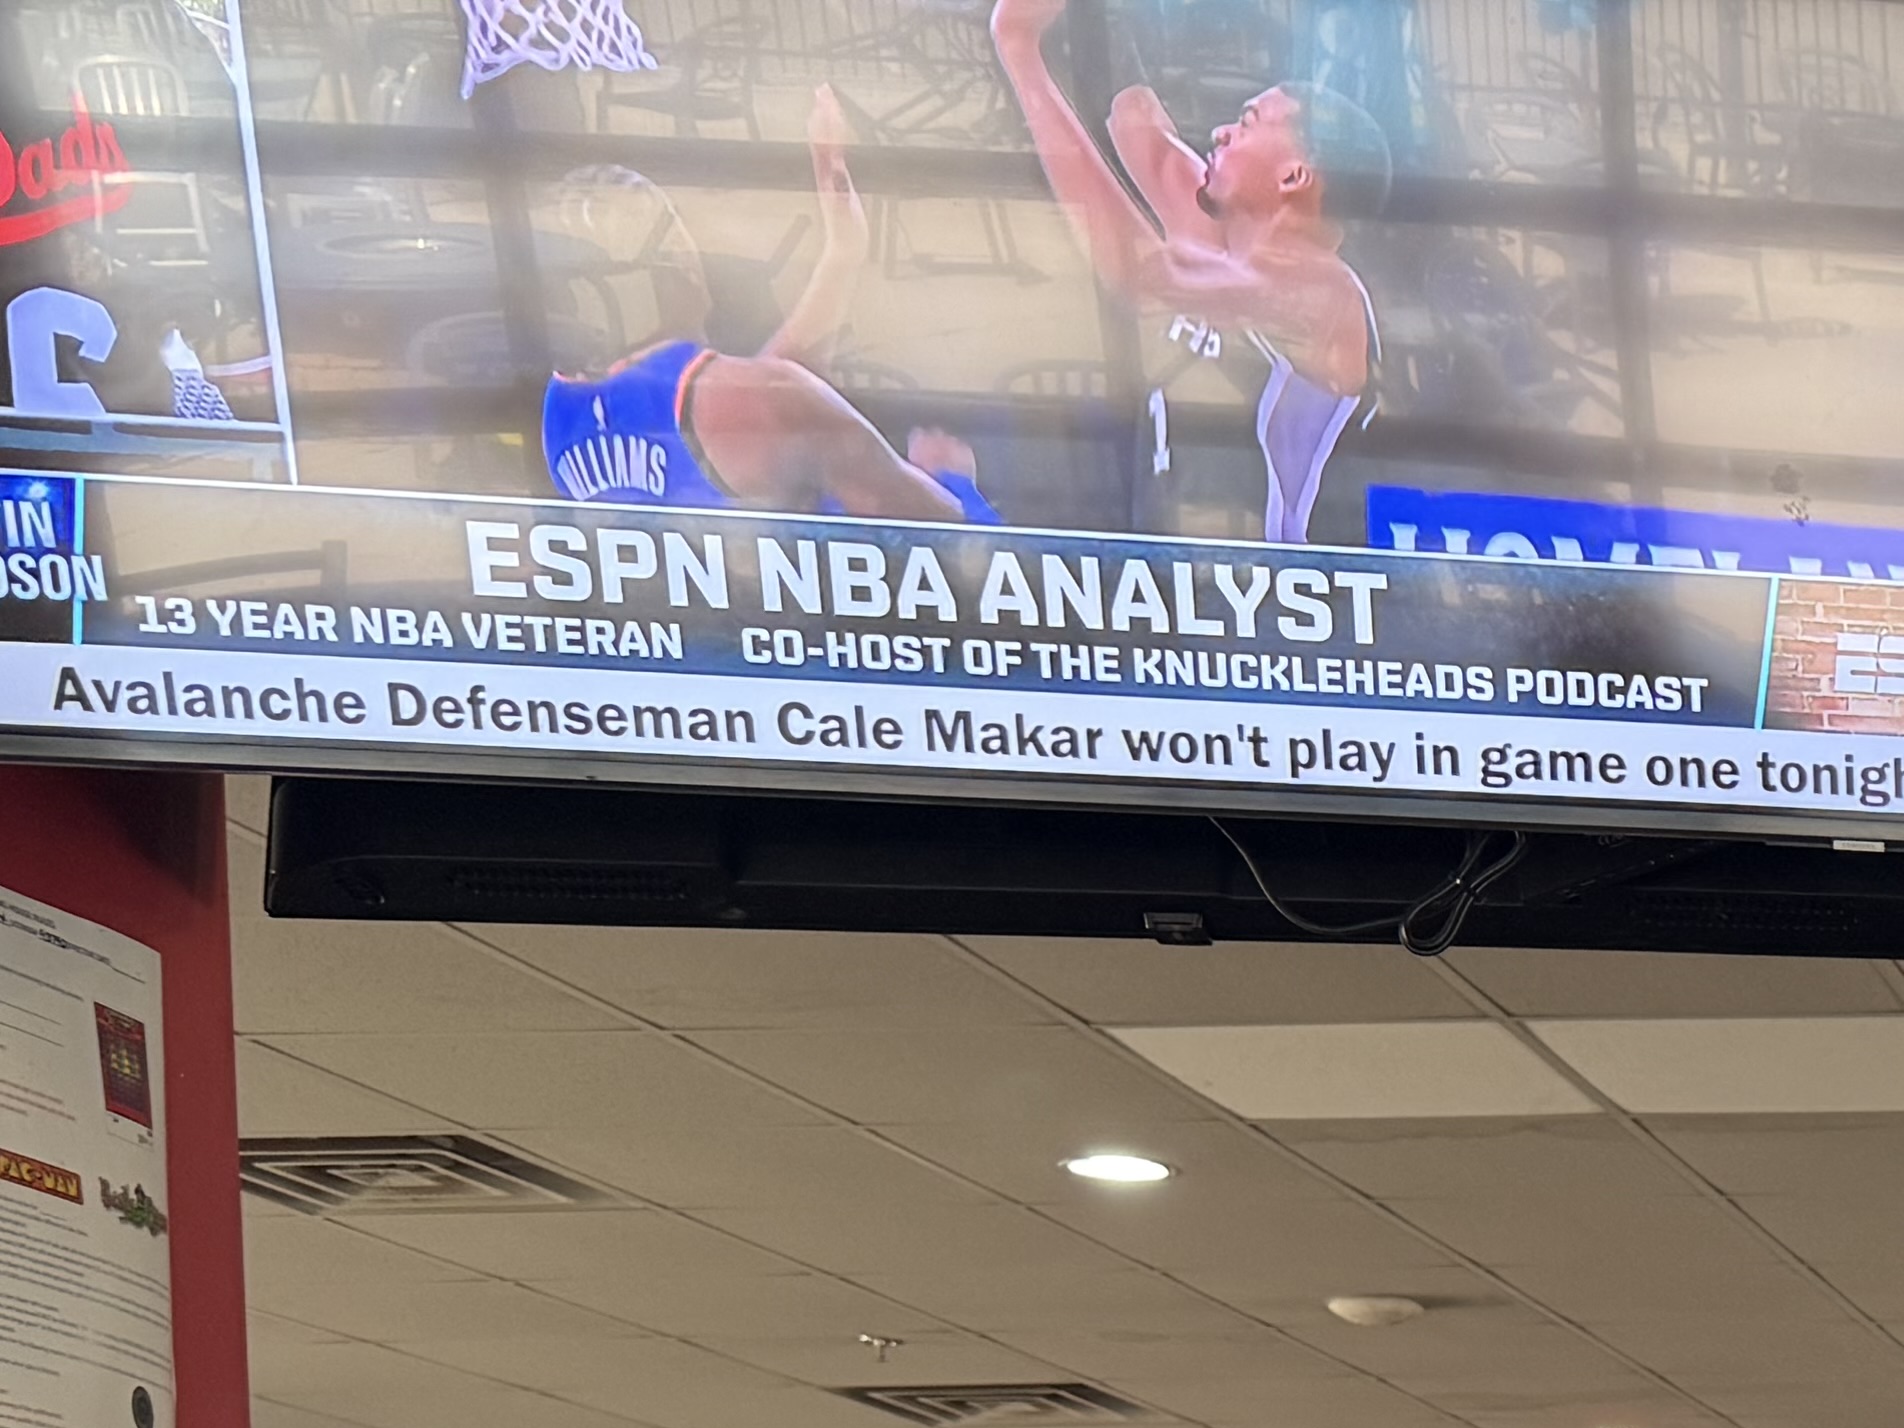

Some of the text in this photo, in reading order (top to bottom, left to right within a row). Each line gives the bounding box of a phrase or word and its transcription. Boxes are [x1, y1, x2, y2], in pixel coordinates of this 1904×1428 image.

[556, 432, 668, 501] WILLIAMS
[465, 519, 1389, 646] ESPN NBA ANALYST
[137, 594, 1709, 714] 13 YEAR NBA VETERAN CO-HOST OF THE KNUCKLEHEADS PODCAST
[53, 666, 368, 727] Avalanche
[388, 680, 757, 747] Defenseman
[775, 698, 904, 753] Cale
[923, 706, 1104, 761] Makar
[1120, 722, 1271, 770] won't
[1287, 725, 1396, 785] play
[1413, 729, 1462, 779] in
[1479, 746, 1628, 790] game
[1644, 750, 1741, 793] one
